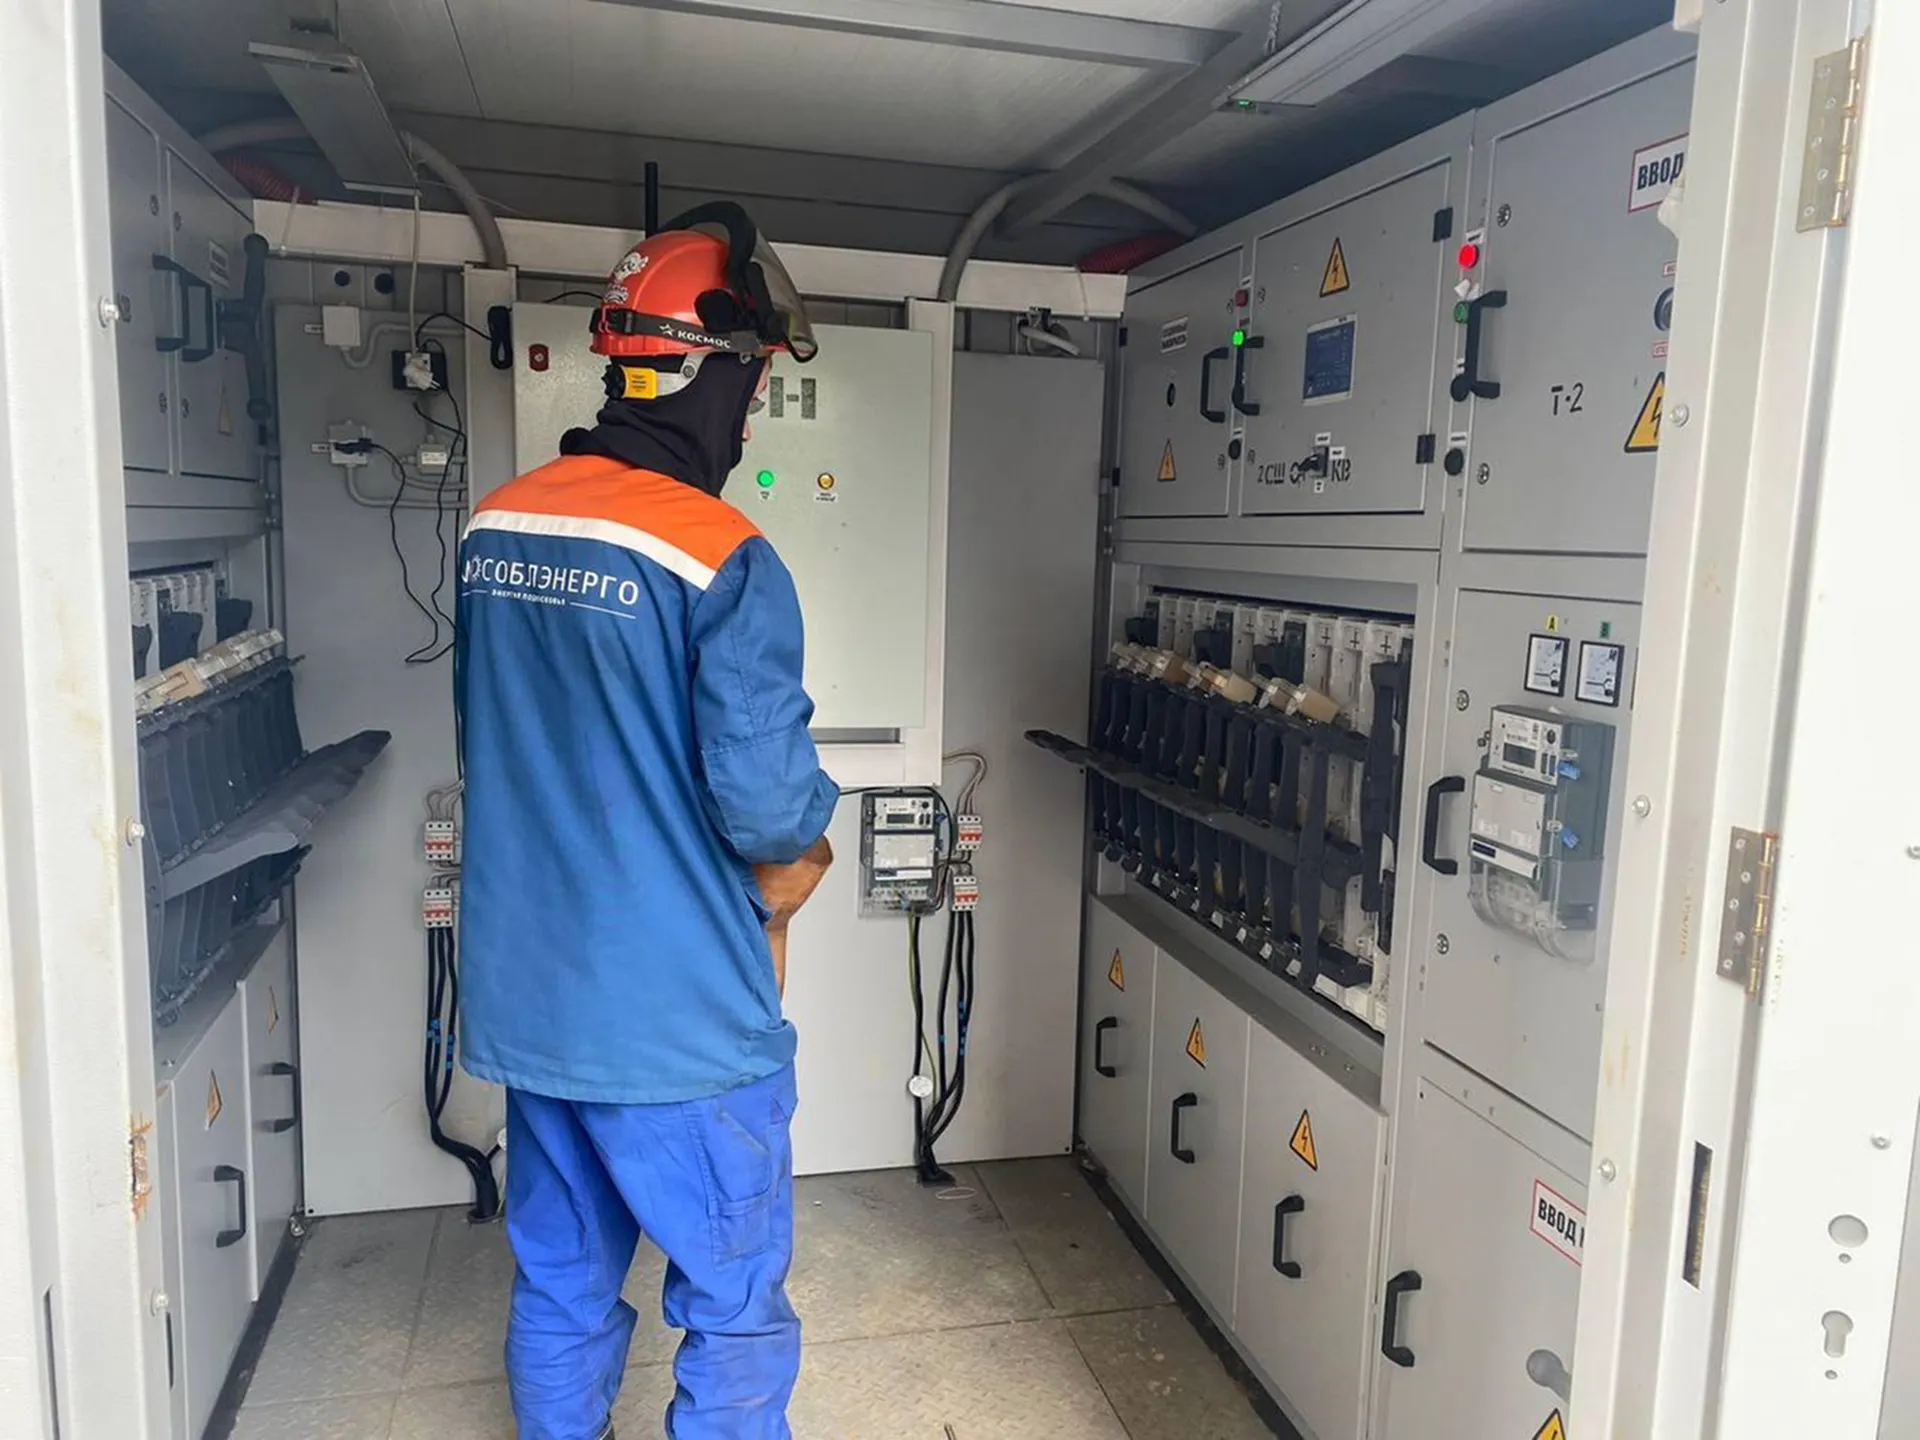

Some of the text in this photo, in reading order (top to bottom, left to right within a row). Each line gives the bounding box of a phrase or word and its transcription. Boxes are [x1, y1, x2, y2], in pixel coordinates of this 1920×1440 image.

[1637, 152, 1685, 191] ВВОД
[677, 330, 732, 349] КОСМОС
[1538, 1197, 1577, 1247] ВВОД
